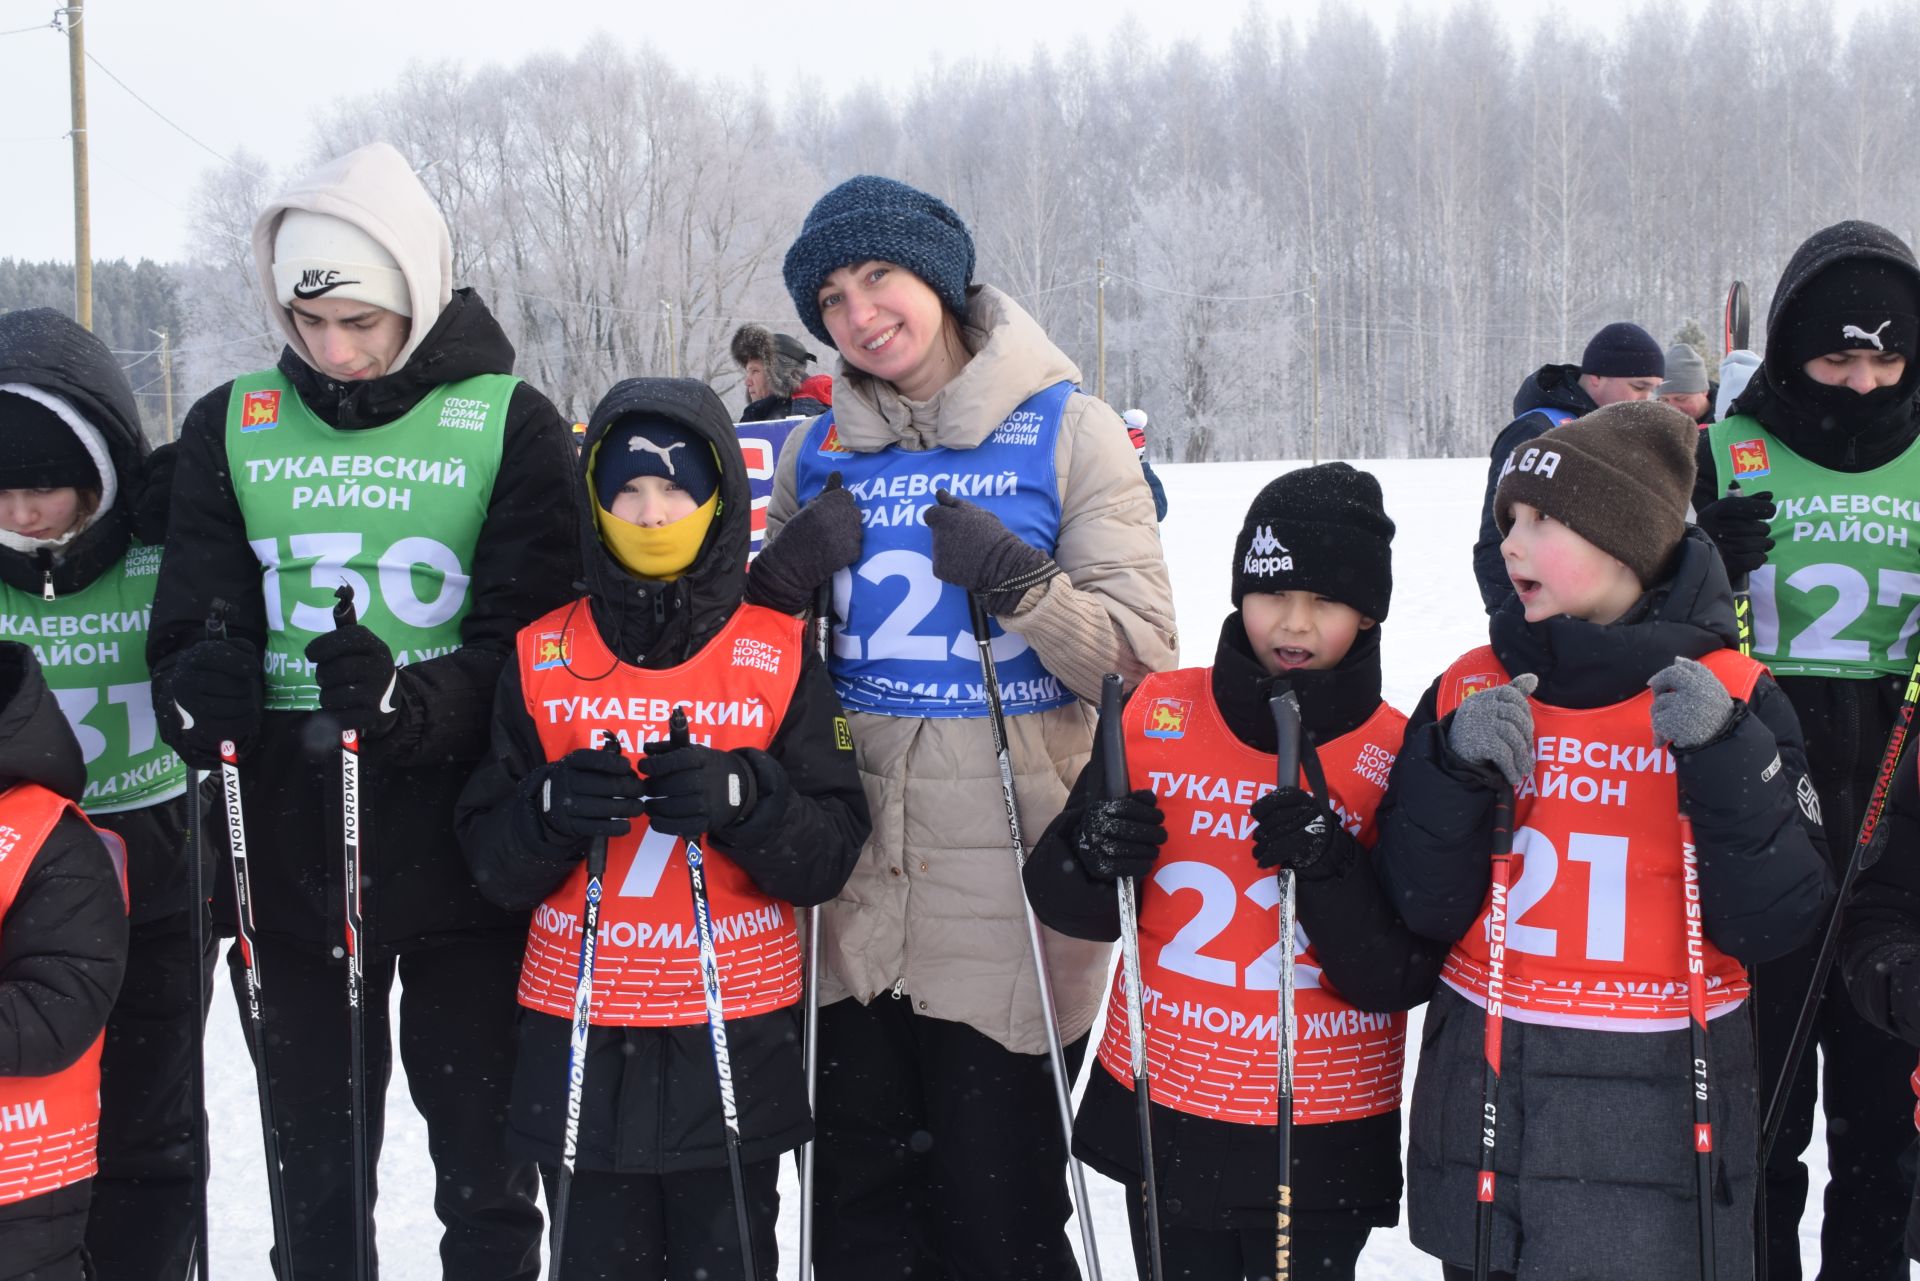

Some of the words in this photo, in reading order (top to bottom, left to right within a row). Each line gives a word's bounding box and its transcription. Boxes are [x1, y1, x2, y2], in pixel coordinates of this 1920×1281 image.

[301, 269, 340, 287] NIKE
[441, 407, 487, 420] НОРМА
[445, 397, 482, 409] СПОРТ
[1009, 411, 1036, 422] ОРТ
[438, 417, 484, 431] ЖИЗНИ
[992, 433, 1038, 446] ЖИЗНИ
[246, 456, 466, 488] ТУКАЕВСКИЙ
[823, 470, 1018, 501] КАЕВСКИЙ
[292, 479, 411, 511] РАЙОН
[1792, 515, 1908, 548] РАЙОН
[125, 565, 160, 577] ЖИЗН
[126, 554, 161, 567] НОРМ
[1243, 555, 1293, 578] Kappa
[248, 532, 470, 632] 130
[0, 603, 152, 636] КАЕВСКИ
[1748, 562, 1920, 661] 127
[32, 639, 119, 666] АЙОН
[733, 647, 780, 665] НОРМА
[735, 638, 774, 653] СПОРТ
[731, 656, 778, 674] ЖИЗНИ
[544, 696, 763, 728] ТУКАЕВСКИЙ
[590, 724, 711, 754] РАЙН
[1363, 743, 1396, 764] СПОР
[1353, 762, 1389, 791] ЖИЗН
[1515, 765, 1627, 806] АЙОН
[226, 770, 244, 852] NORDWAY
[343, 757, 357, 840] NORDWAY
[1190, 810, 1260, 841] РАЙ
[692, 868, 703, 893] XC
[1484, 826, 1630, 962] 21
[590, 904, 598, 928] XC
[1682, 842, 1704, 974] MADSHUS
[696, 899, 713, 952] JUNIOR
[1154, 861, 1322, 991] 22
[580, 931, 596, 991] JUNIOR
[1487, 882, 1507, 1017] MADSHUS
[247, 969, 255, 1000] JUNIOR
[350, 989, 358, 1008] XC
[251, 1000, 260, 1020] XC
[1303, 1010, 1392, 1040] ЖИЗНИ
[711, 1009, 740, 1136] NORDWAY
[1694, 1059, 1706, 1077] CT
[1695, 1081, 1708, 1100] 90
[563, 1046, 587, 1175] NORDWAY
[1484, 1103, 1496, 1124] CT
[1482, 1127, 1495, 1147] 90
